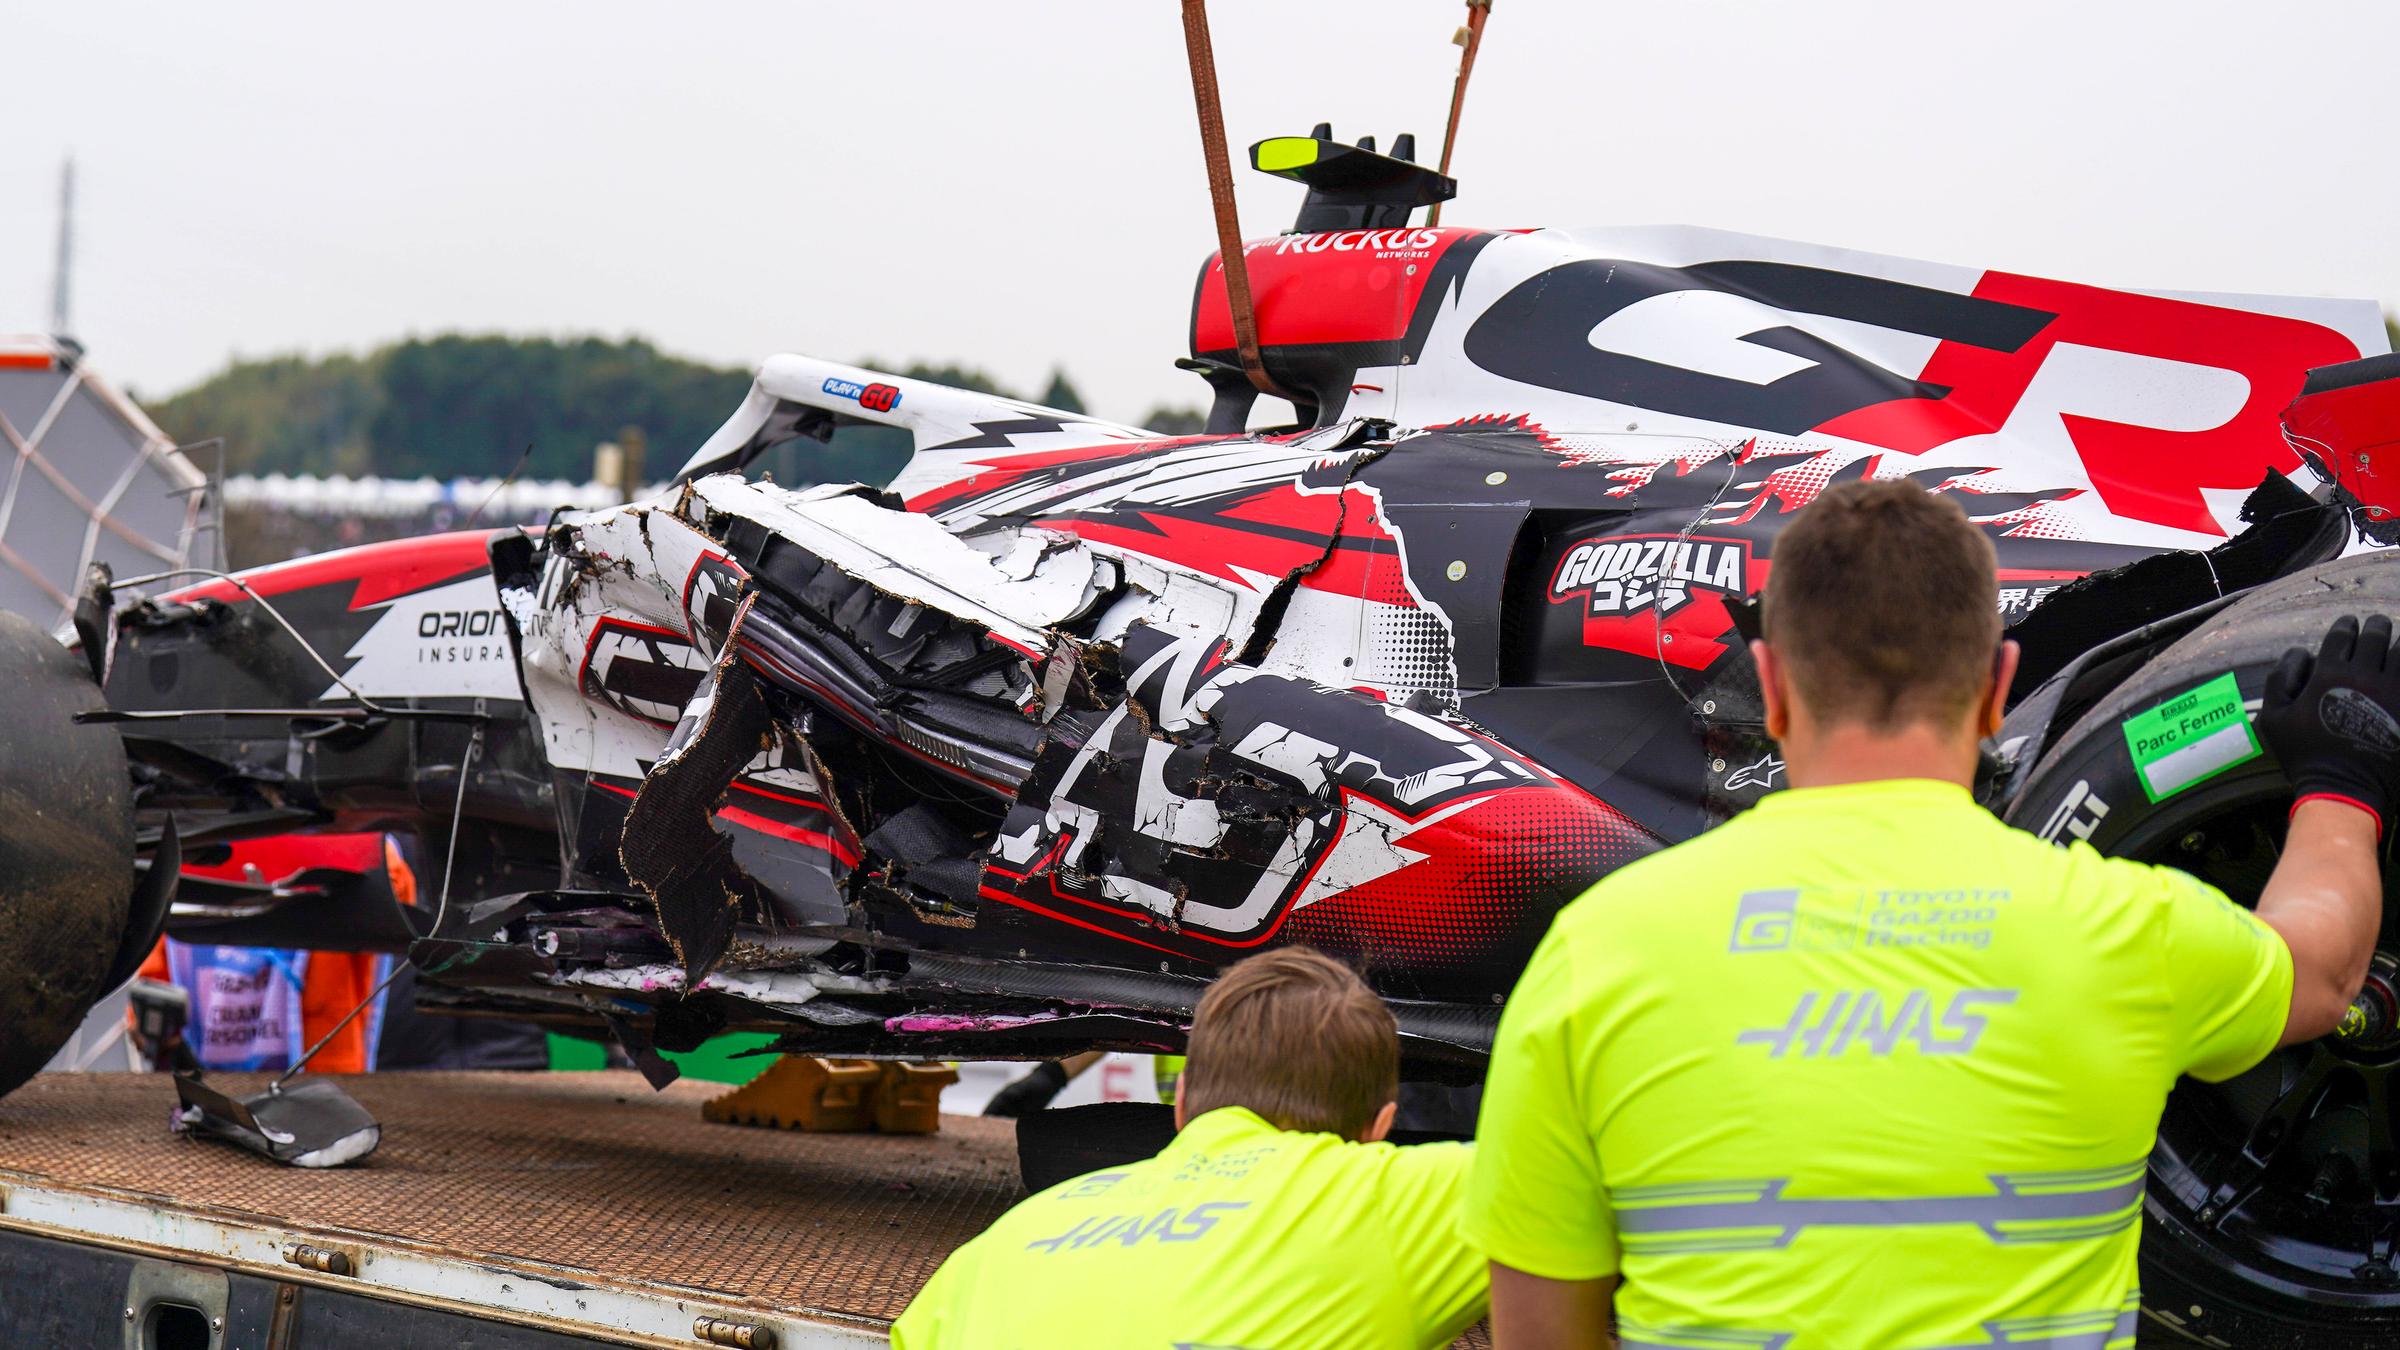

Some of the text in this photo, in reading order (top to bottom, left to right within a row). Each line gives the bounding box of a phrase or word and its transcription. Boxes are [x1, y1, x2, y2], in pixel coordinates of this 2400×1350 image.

[1276, 228, 1446, 255] RUCKUS
[1375, 250, 1430, 259] NETWORKS
[859, 383, 900, 412] GO
[1555, 541, 1741, 593] GODZILLA
[1593, 572, 1688, 612] ゴジラ
[418, 646, 504, 663] INSURA
[2136, 729, 2177, 756] Parc
[2179, 702, 2237, 735] Ferme
[1878, 889, 2012, 905] TOYOTA
[1869, 907, 1997, 926] GAZOO
[1864, 929, 1994, 949] Racing
[1736, 988, 2021, 1059] HAAS
[1024, 1201, 1253, 1255] HAAS
